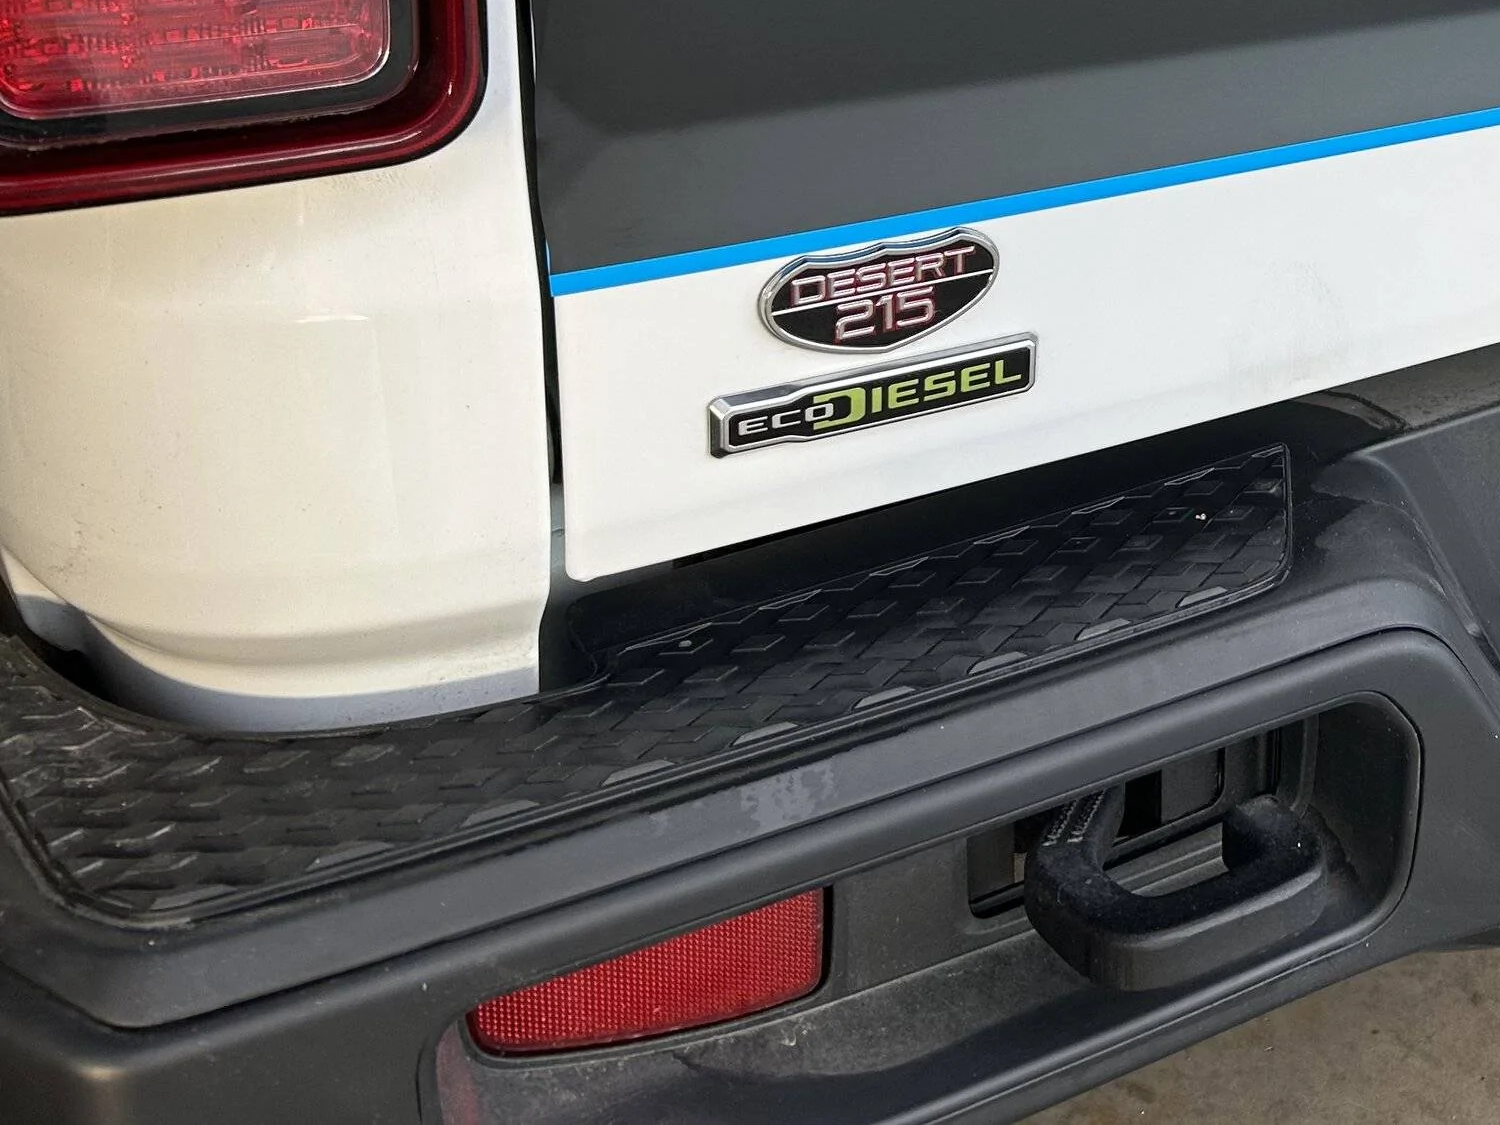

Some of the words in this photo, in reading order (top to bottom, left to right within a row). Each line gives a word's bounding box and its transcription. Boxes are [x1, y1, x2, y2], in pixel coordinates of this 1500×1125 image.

[790, 245, 976, 307] DESERT
[834, 285, 937, 344] 215
[738, 359, 1022, 436] ECODIESEL
